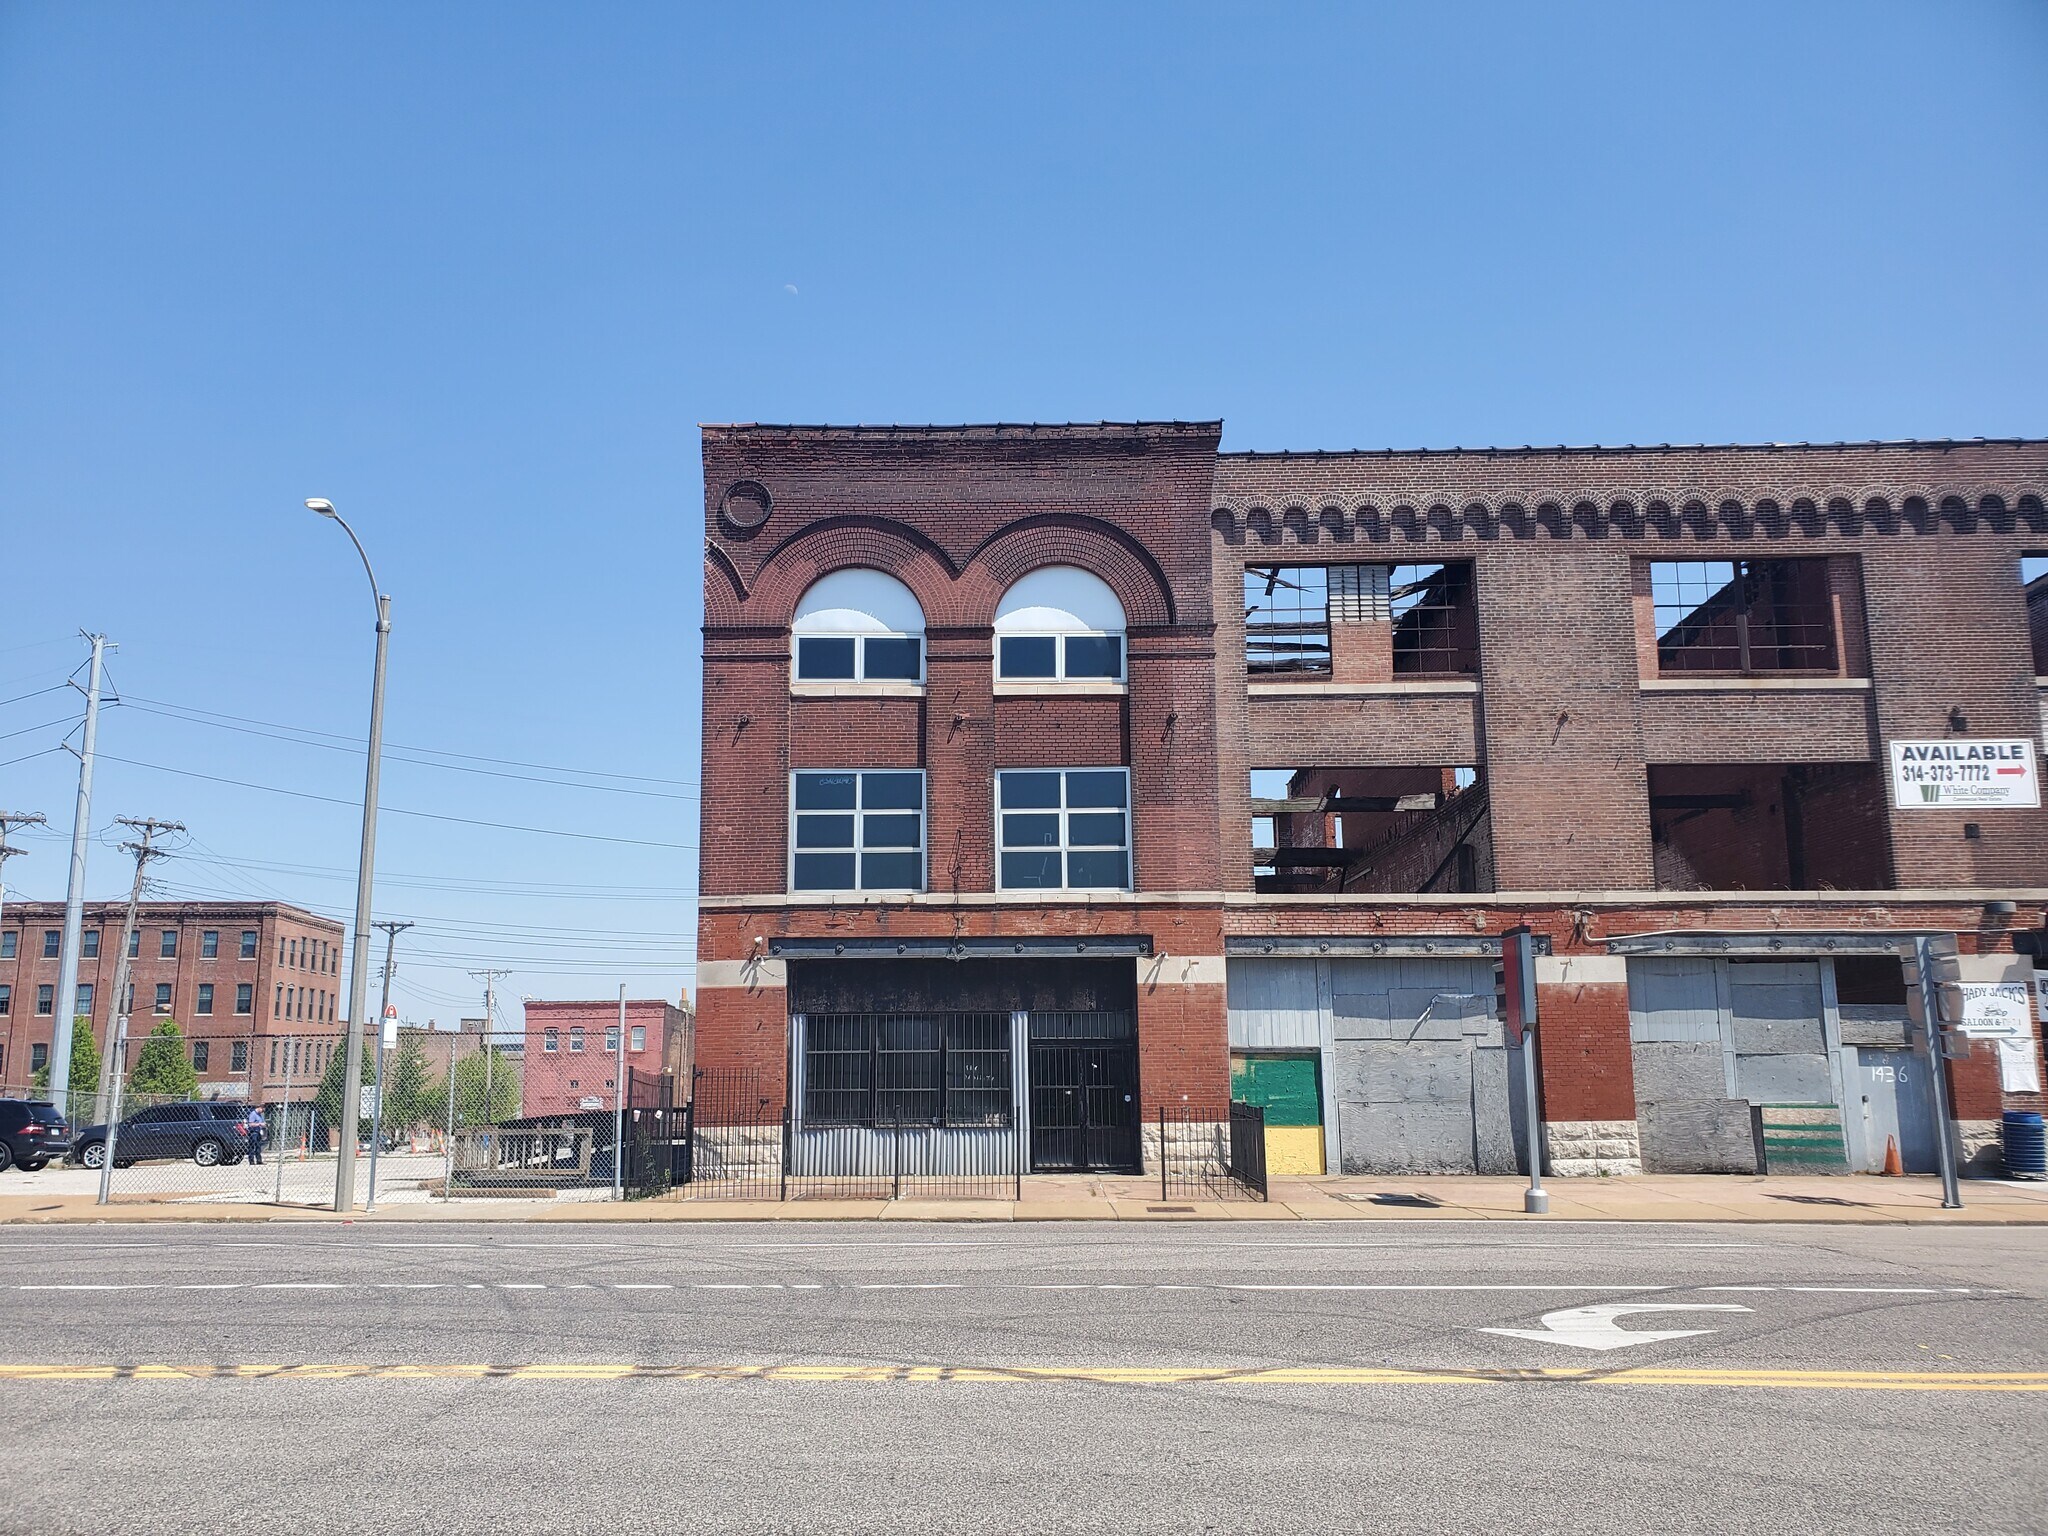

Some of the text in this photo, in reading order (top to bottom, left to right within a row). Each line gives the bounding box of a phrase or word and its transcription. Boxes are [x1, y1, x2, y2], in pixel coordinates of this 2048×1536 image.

[1902, 745, 2025, 761] AVAILABLE
[1902, 764, 1990, 782] 314-373-7772
[1943, 785, 2010, 797] White Company
[1962, 987, 1987, 1001] HADY
[1990, 986, 2025, 1005] JACK'S
[1961, 1018, 1994, 1026] SALOON
[1872, 1066, 1908, 1082] 1436
